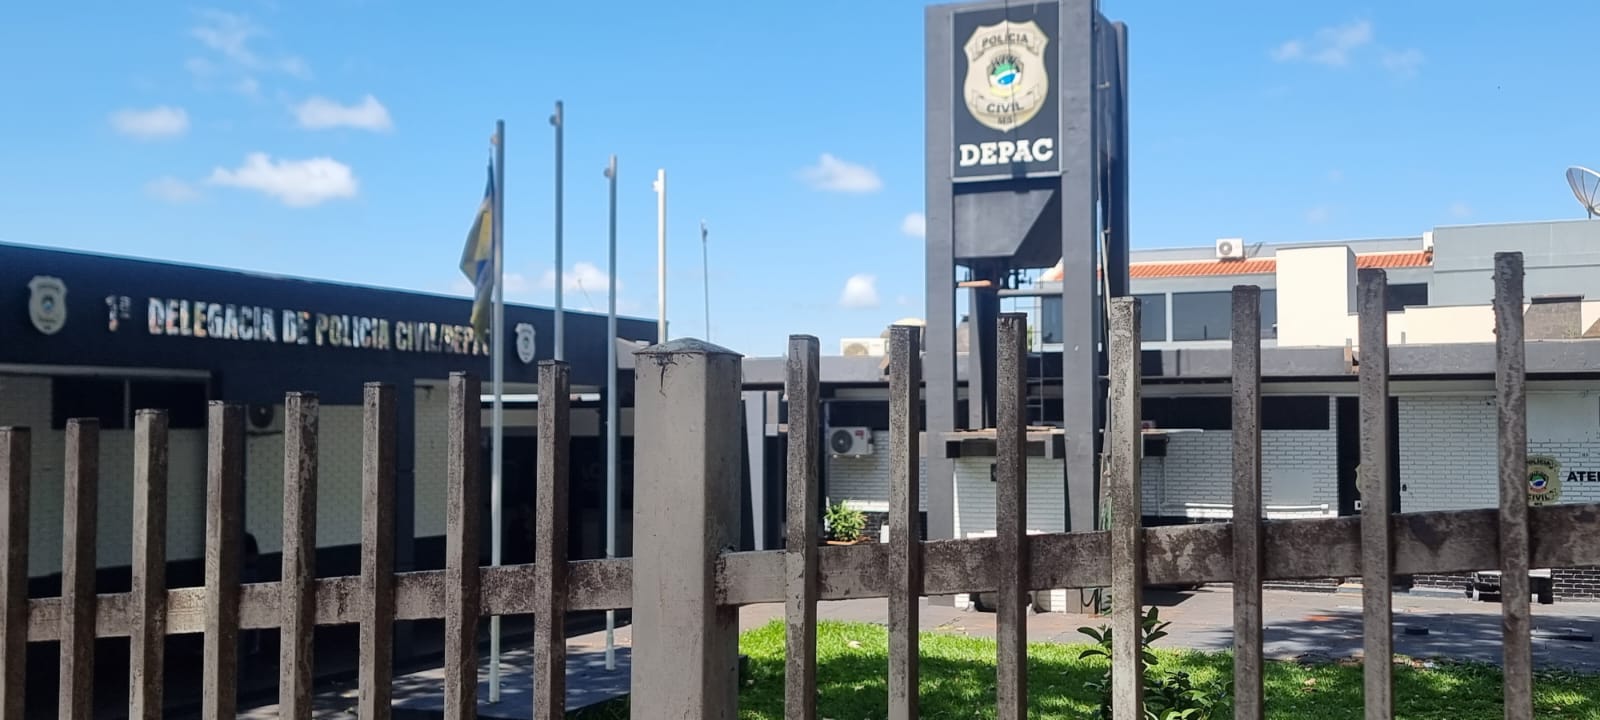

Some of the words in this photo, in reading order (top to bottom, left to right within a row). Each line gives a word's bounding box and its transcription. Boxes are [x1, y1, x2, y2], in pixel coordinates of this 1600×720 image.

[986, 102, 1024, 113] CIVIL
[959, 138, 1054, 166] DEPAC
[148, 297, 277, 342] DELEGACIA
[282, 309, 310, 345] DE
